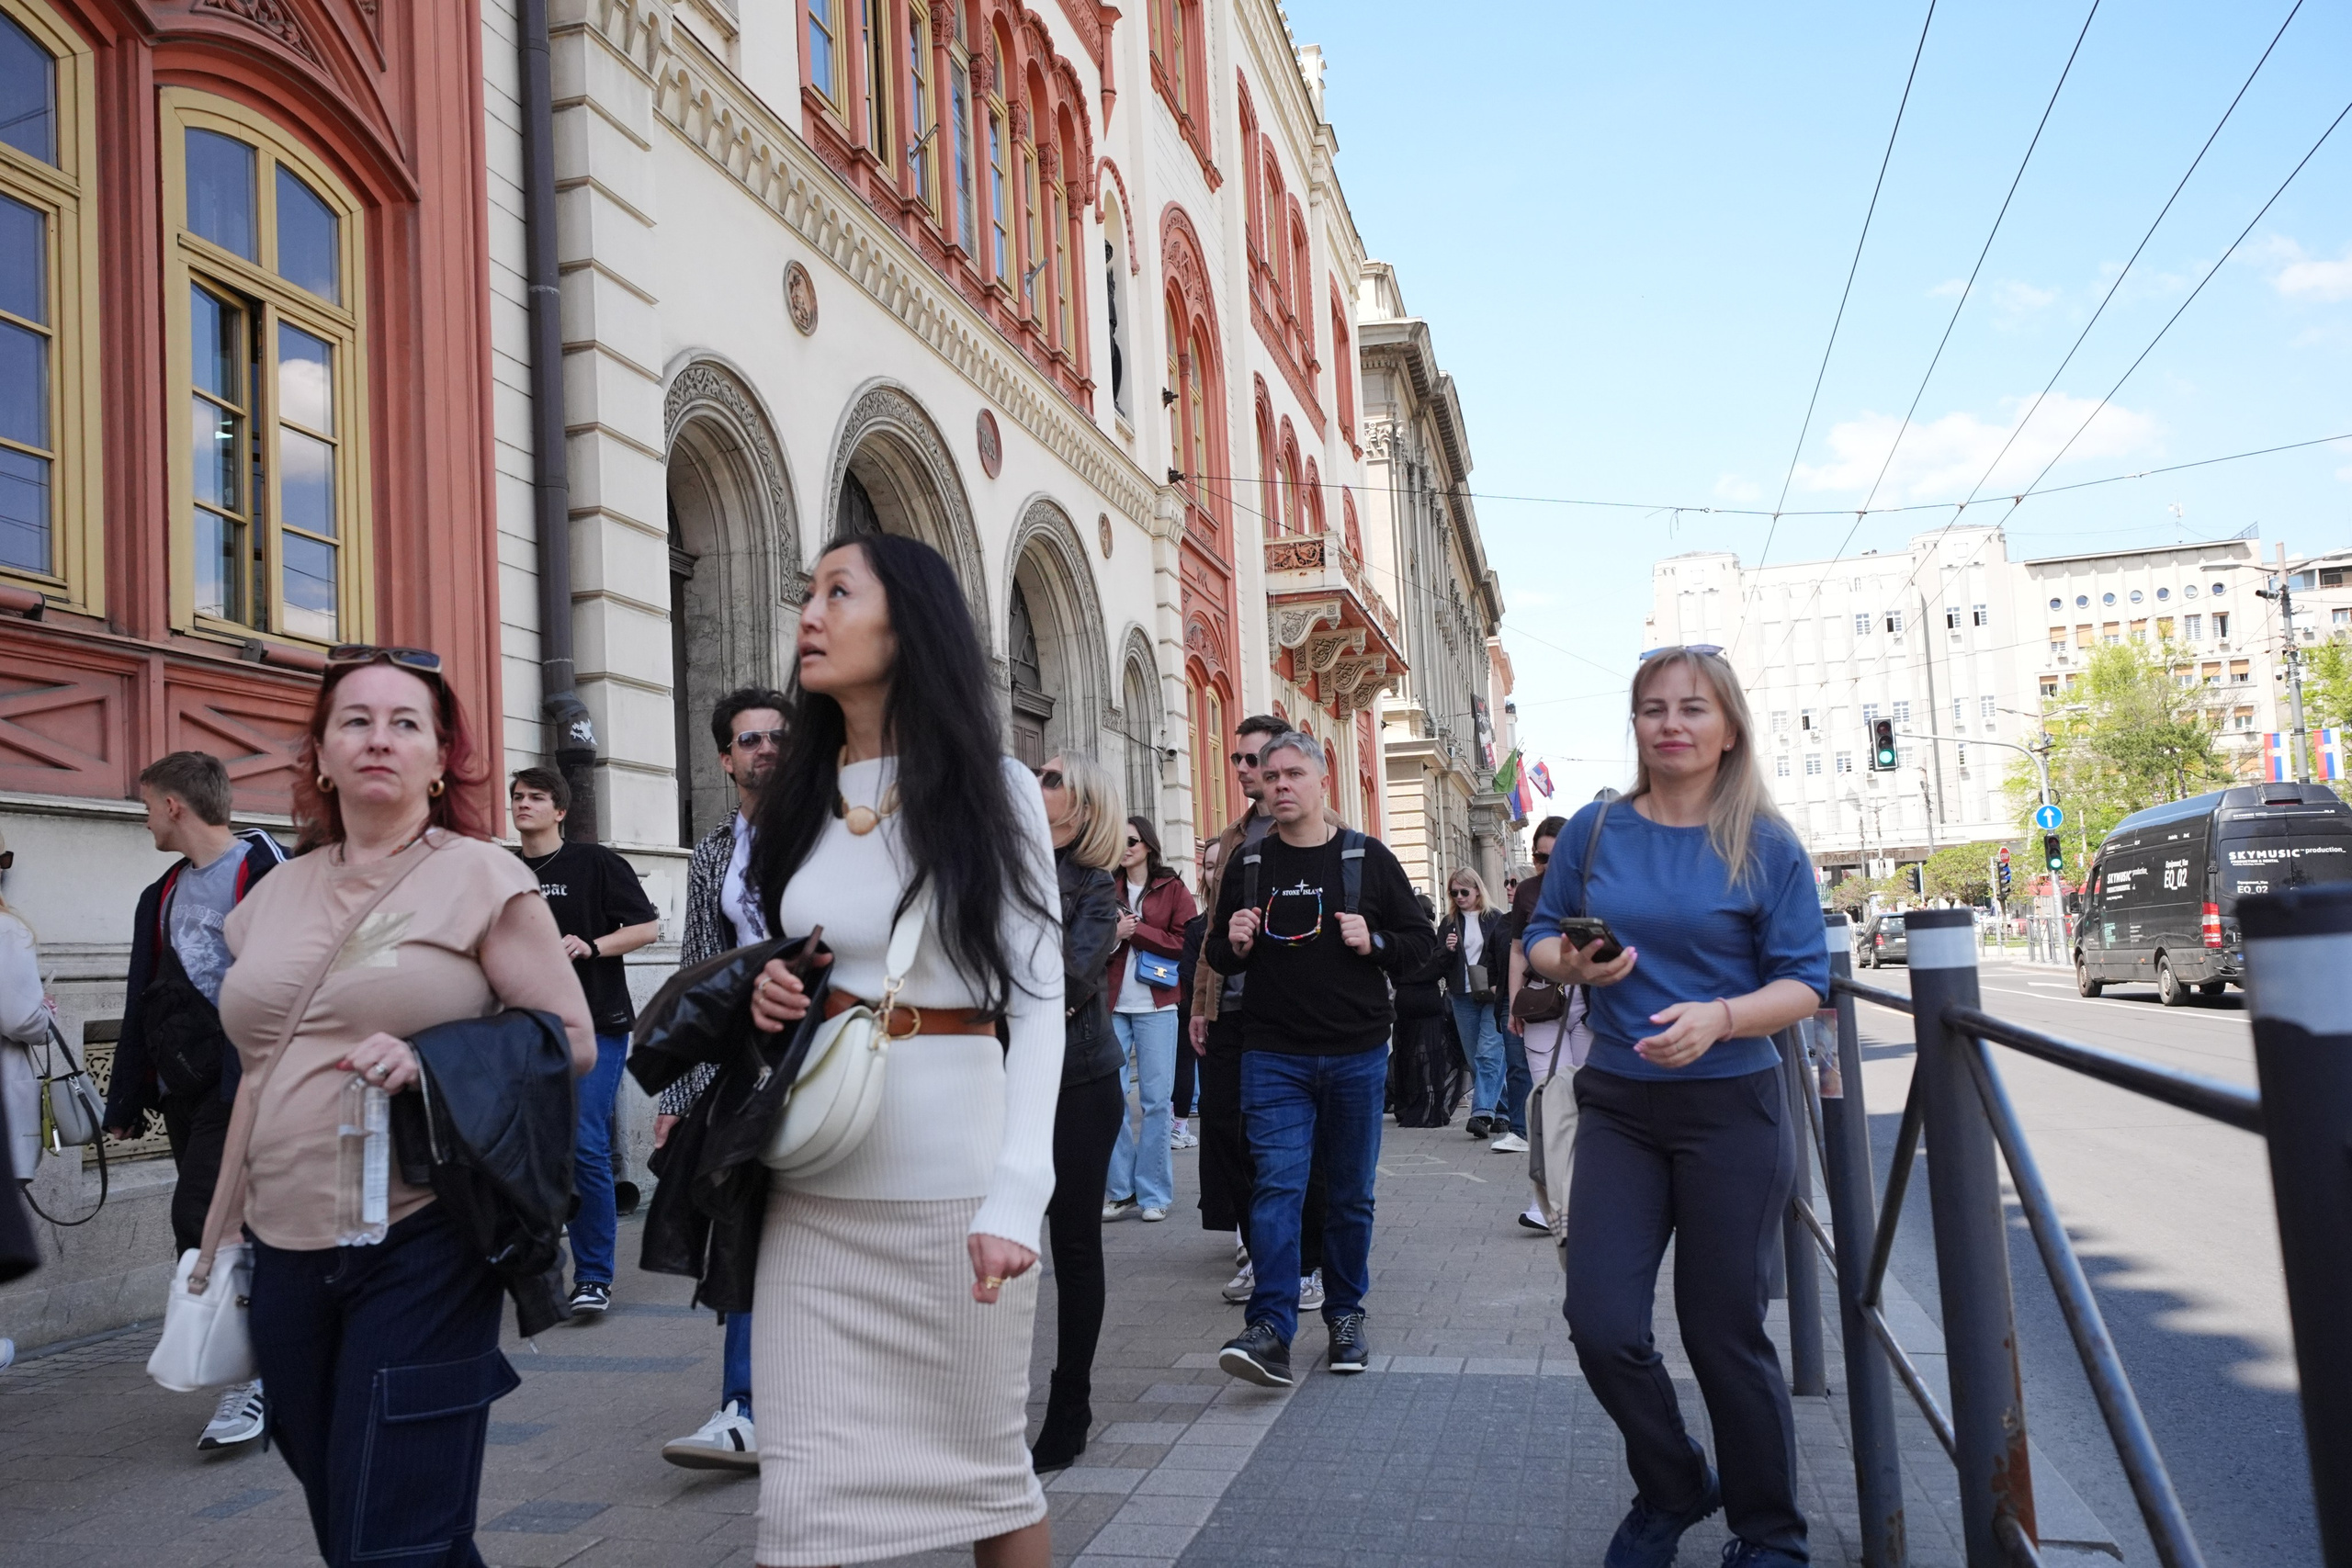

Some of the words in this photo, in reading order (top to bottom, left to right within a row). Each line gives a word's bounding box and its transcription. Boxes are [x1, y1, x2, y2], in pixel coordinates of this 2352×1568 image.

[2229, 849, 2301, 860] SKYMUSIC
[2107, 870, 2132, 885] SKYMUSIC
[2164, 868, 2188, 890] EQ_02
[540, 883, 568, 898] pac
[2237, 886, 2268, 894] EQ_02
